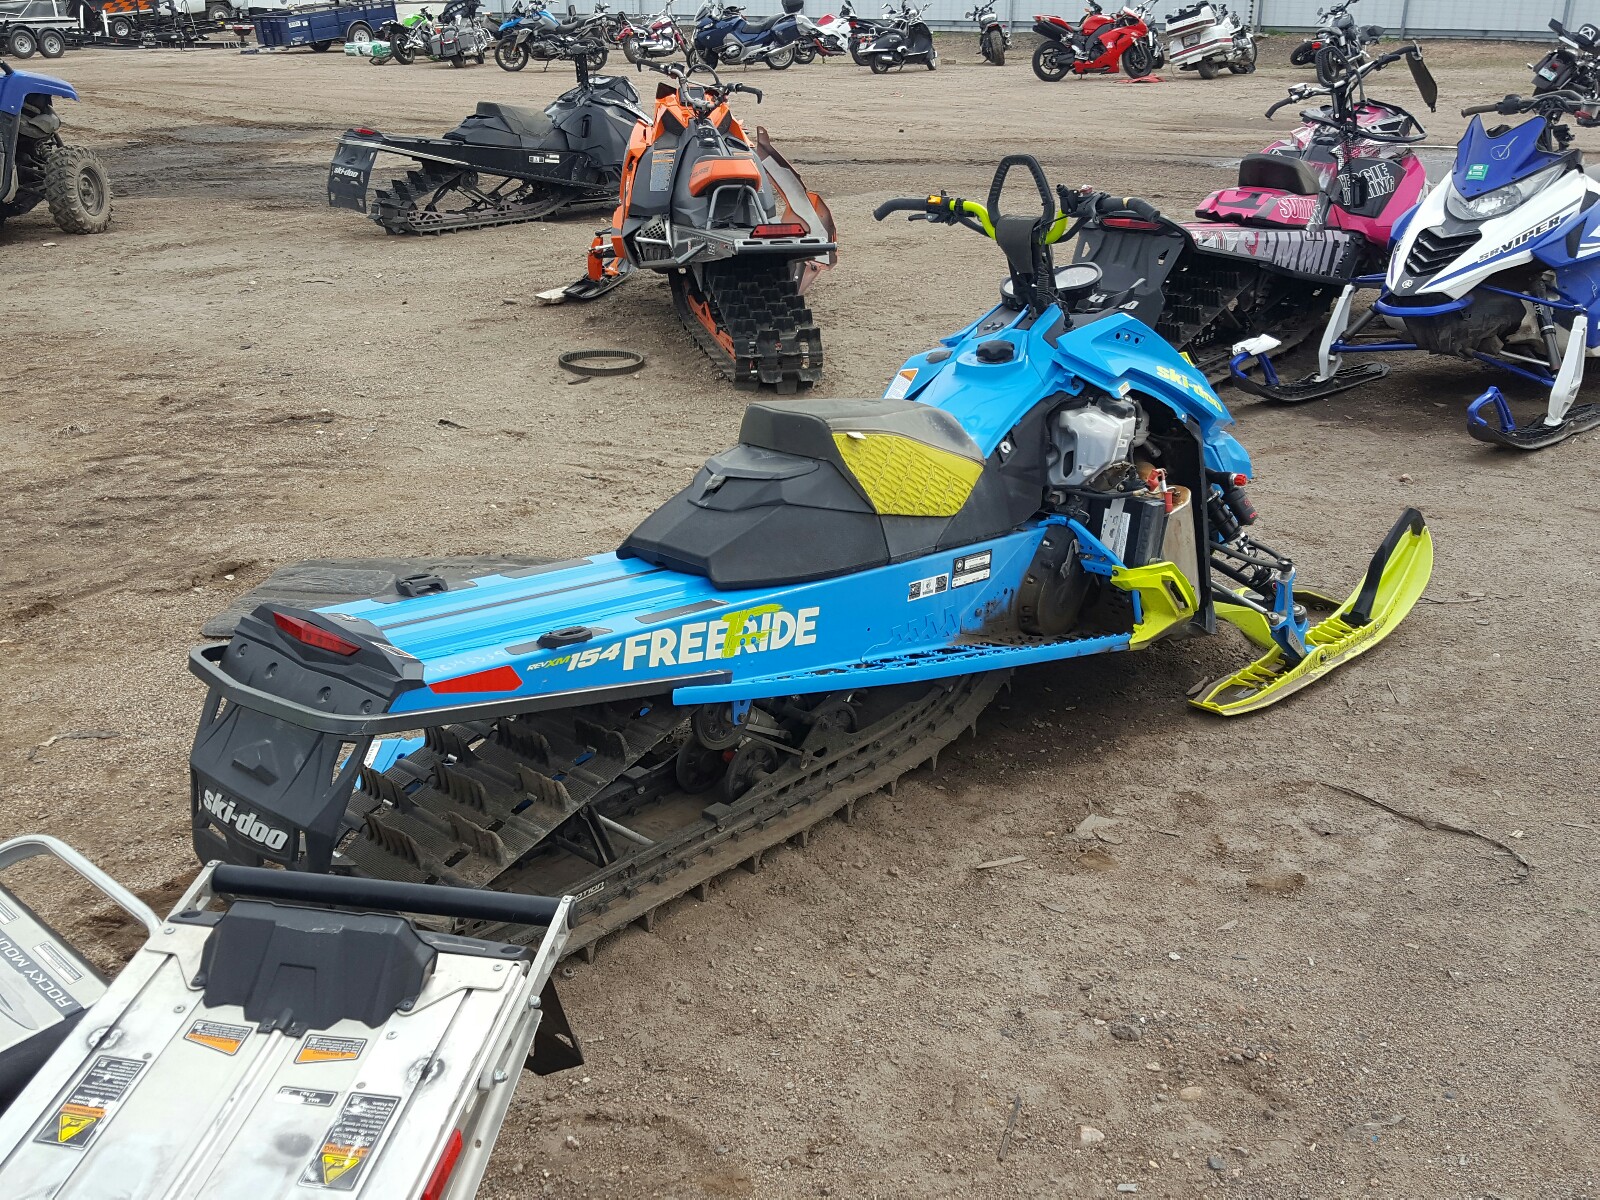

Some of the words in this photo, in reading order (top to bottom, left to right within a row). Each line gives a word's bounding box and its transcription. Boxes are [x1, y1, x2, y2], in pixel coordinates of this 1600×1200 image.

[334, 167, 359, 178] ski-doo
[1156, 365, 1223, 413] ski-doo
[566, 643, 621, 672] 154
[622, 606, 820, 671] FREERIDE
[203, 789, 289, 850] ski-doo
[0, 937, 30, 967] MOU
[24, 969, 73, 1008] ROCKY
